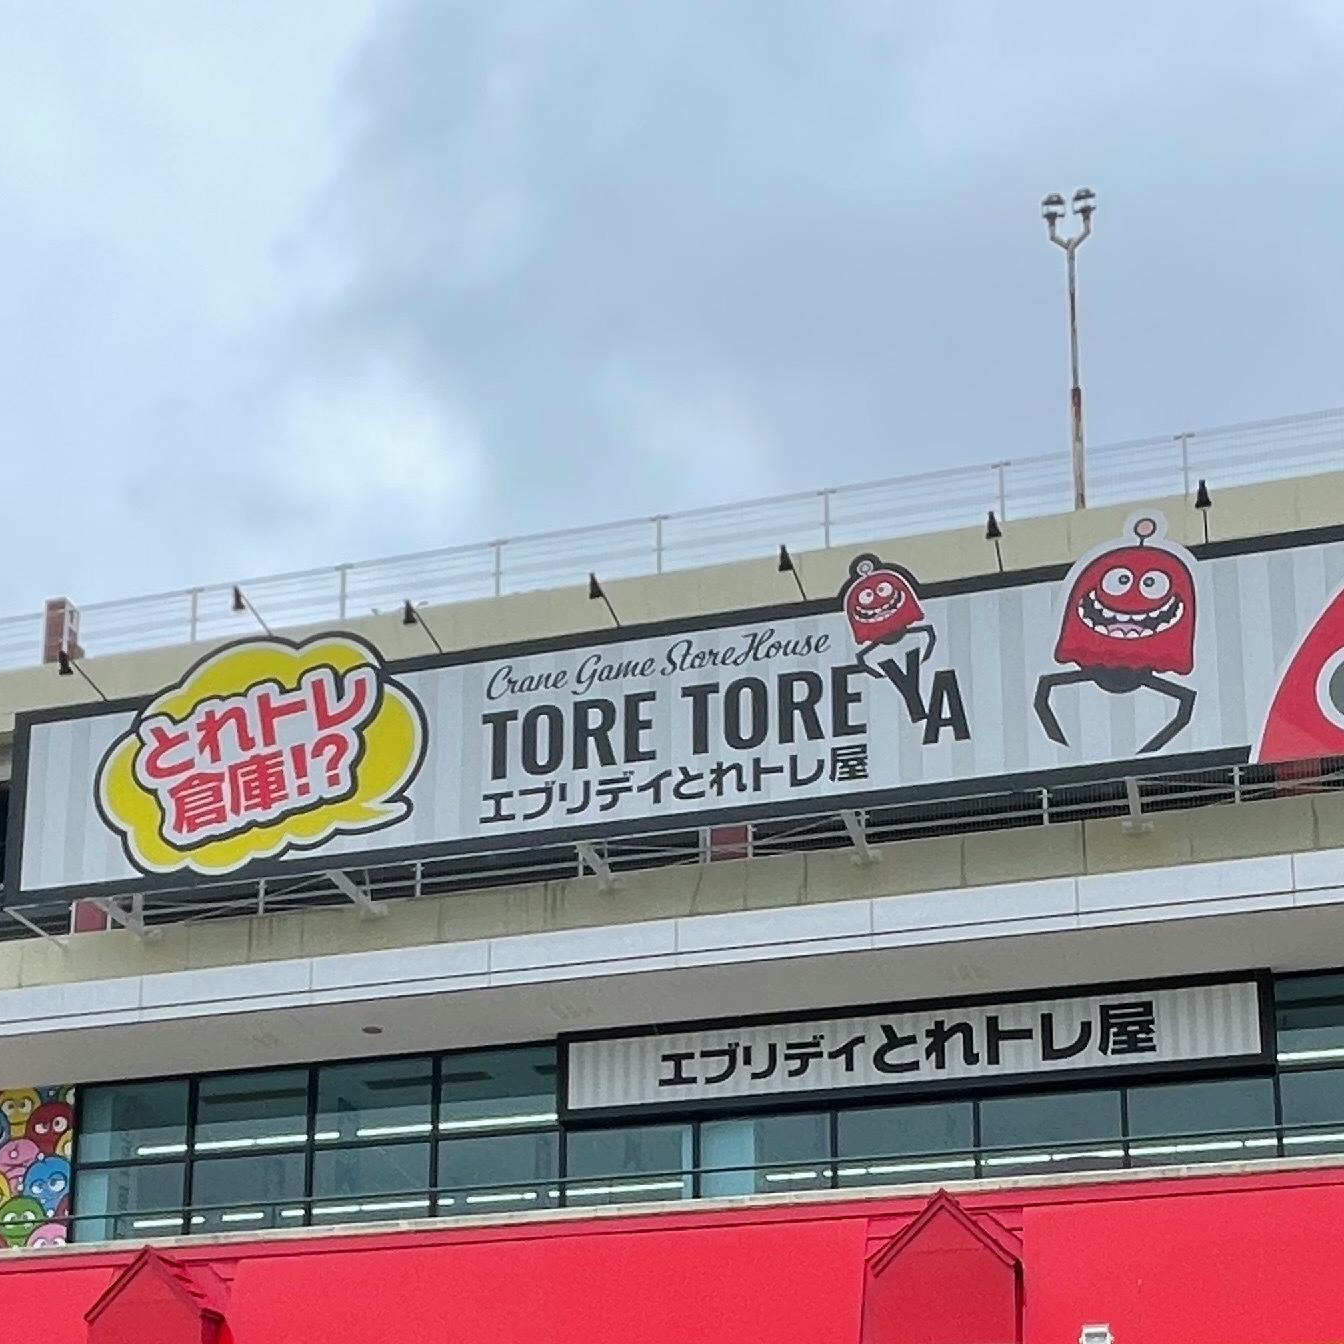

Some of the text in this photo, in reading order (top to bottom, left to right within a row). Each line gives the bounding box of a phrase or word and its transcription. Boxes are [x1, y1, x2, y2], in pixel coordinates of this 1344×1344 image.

[482, 647, 971, 780] TORE TORE YA
[486, 665, 567, 700] Crane
[571, 654, 656, 696] Game
[143, 675, 369, 780] とれトレ
[478, 743, 869, 824] エブリデイとれトレ屋
[658, 1000, 1158, 1088] エブリデイとれトレ屋
